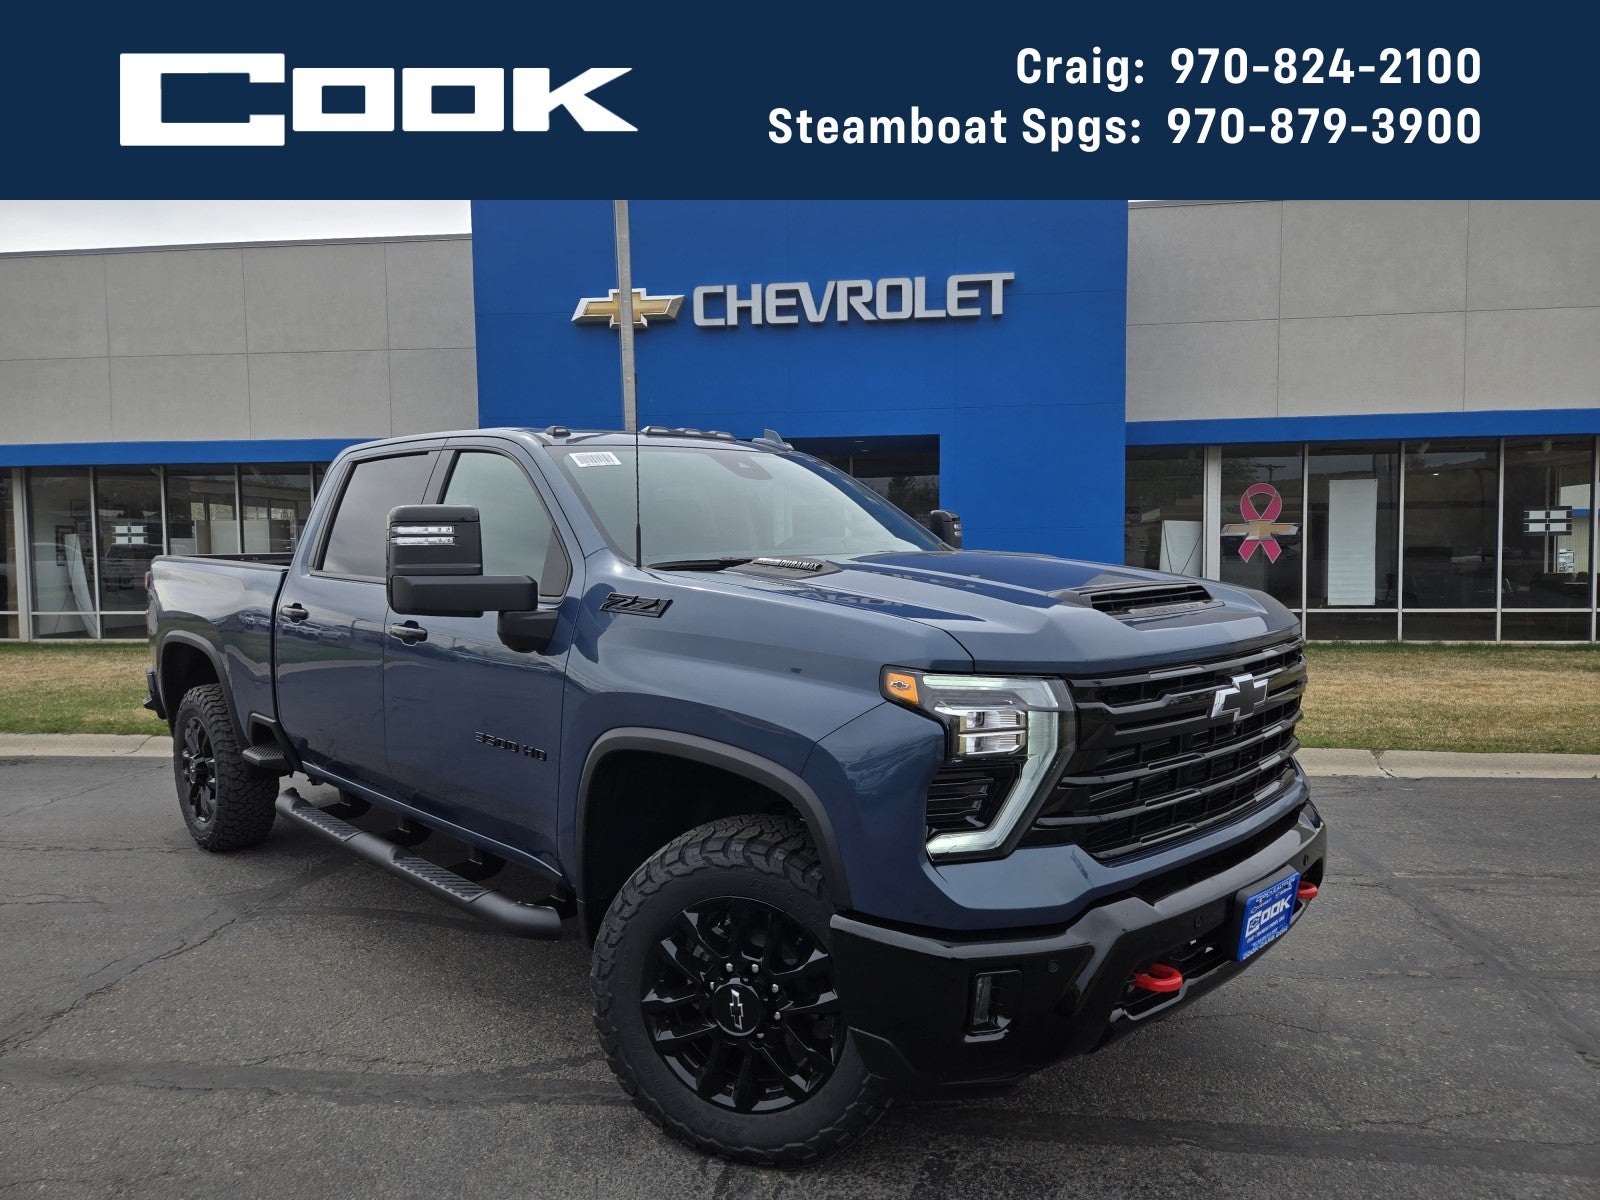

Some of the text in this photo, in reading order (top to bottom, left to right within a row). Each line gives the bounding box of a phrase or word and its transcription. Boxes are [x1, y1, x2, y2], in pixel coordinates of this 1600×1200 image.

[693, 271, 1015, 328] CHEVROLET
[600, 592, 673, 618] Z71
[475, 731, 547, 761] 3500 HD
